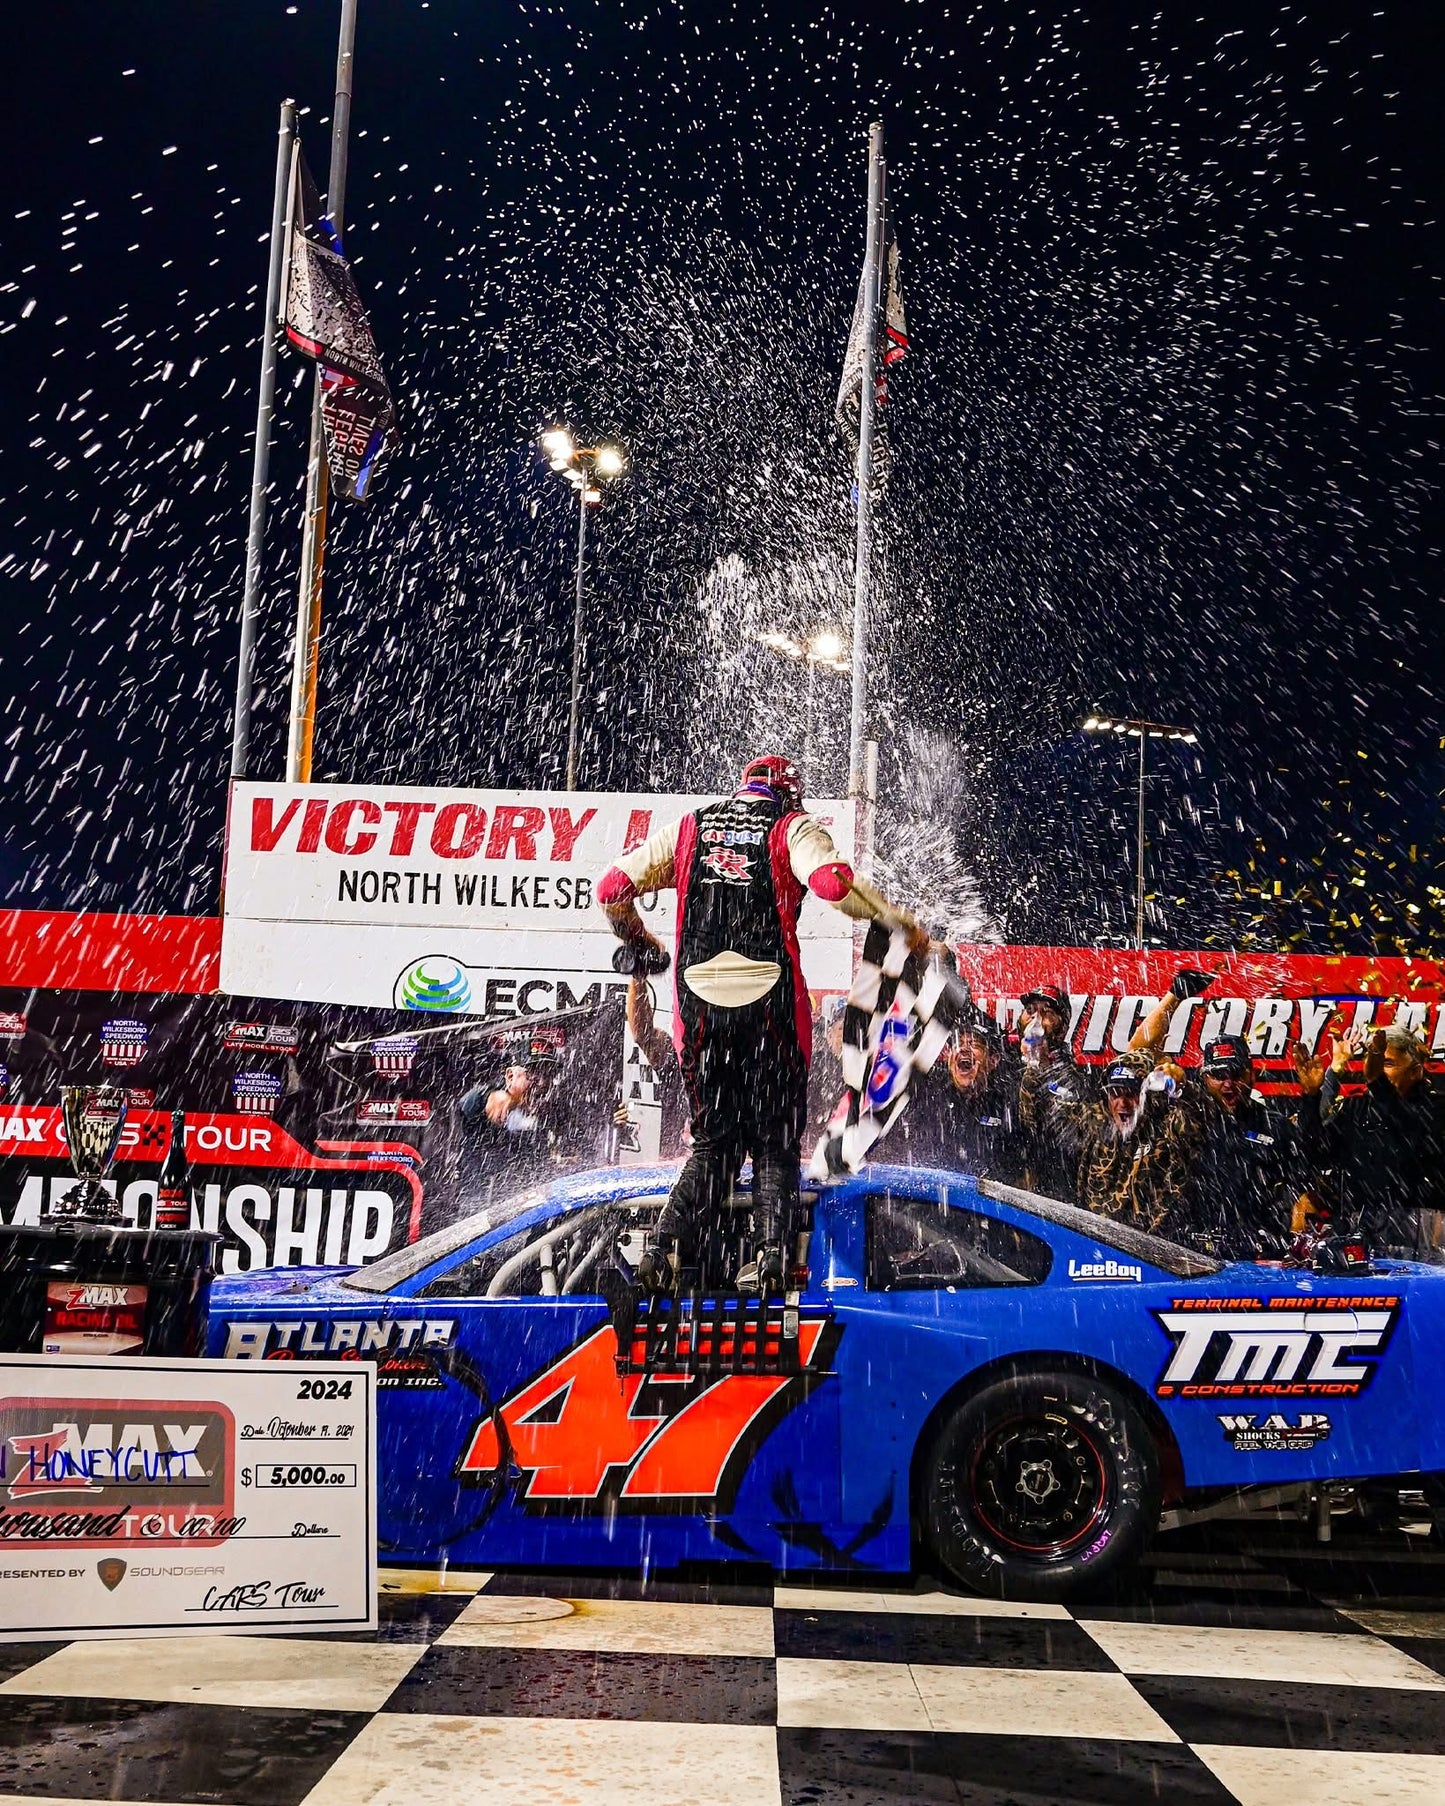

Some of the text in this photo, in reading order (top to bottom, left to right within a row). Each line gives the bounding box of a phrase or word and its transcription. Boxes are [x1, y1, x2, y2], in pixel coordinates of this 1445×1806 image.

[250, 797, 598, 863] VICTORY
[338, 869, 441, 904] NORTH
[102, 1026, 147, 1034] WILKESBORO
[105, 1032, 144, 1040] SPEEDWAY
[271, 1035, 296, 1043] TOUR
[234, 1078, 281, 1087] WILKESBORO
[245, 1072, 271, 1080] NORTH
[236, 1085, 277, 1093] SPEEDWAY
[1068, 1259, 1142, 1282] LeeBoy
[1172, 1297, 1398, 1310] TERMINAL MAINTENANCE
[56, 1311, 112, 1327] RACING
[223, 1320, 455, 1361] ATLANTA
[1158, 1312, 1392, 1382] TMC
[296, 1379, 353, 1400] 2024
[1181, 1384, 1360, 1396] CONSTRUCTION
[460, 1320, 826, 1498] 47
[1236, 1431, 1281, 1440] SHOCKS
[1263, 1440, 1287, 1449] THE
[1288, 1440, 1314, 1449] GRIP
[29, 1442, 198, 1483] HONEYCUTT
[240, 1466, 346, 1488] $ 5,000.00
[178, 1511, 247, 1537] 00/100
[68, 1569, 86, 1578] BY
[130, 1566, 225, 1577] SOUNDGEAR
[202, 1580, 326, 1611] CARS Tour
